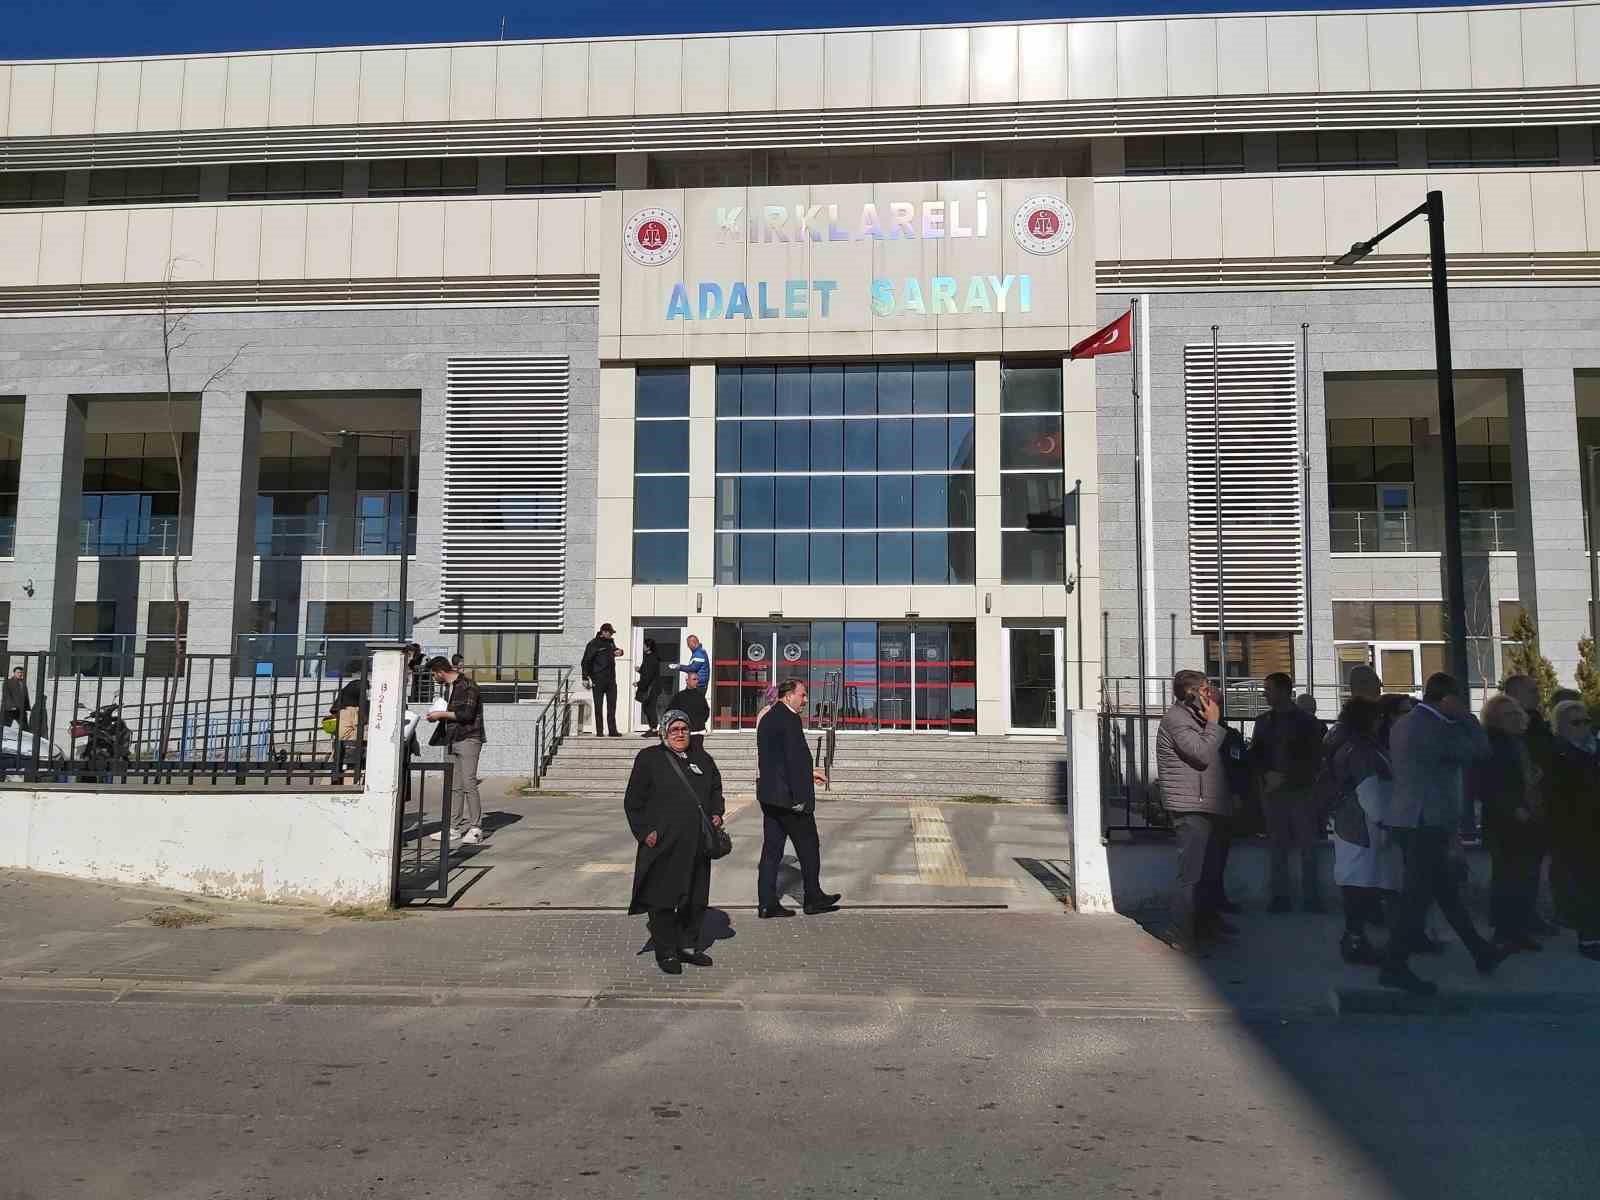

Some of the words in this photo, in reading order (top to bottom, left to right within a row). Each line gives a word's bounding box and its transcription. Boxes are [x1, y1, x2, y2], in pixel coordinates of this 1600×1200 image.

[715, 191, 988, 243] KIRKLARELİ
[665, 279, 838, 320] ADALET
[869, 273, 1032, 317] SARAYI
